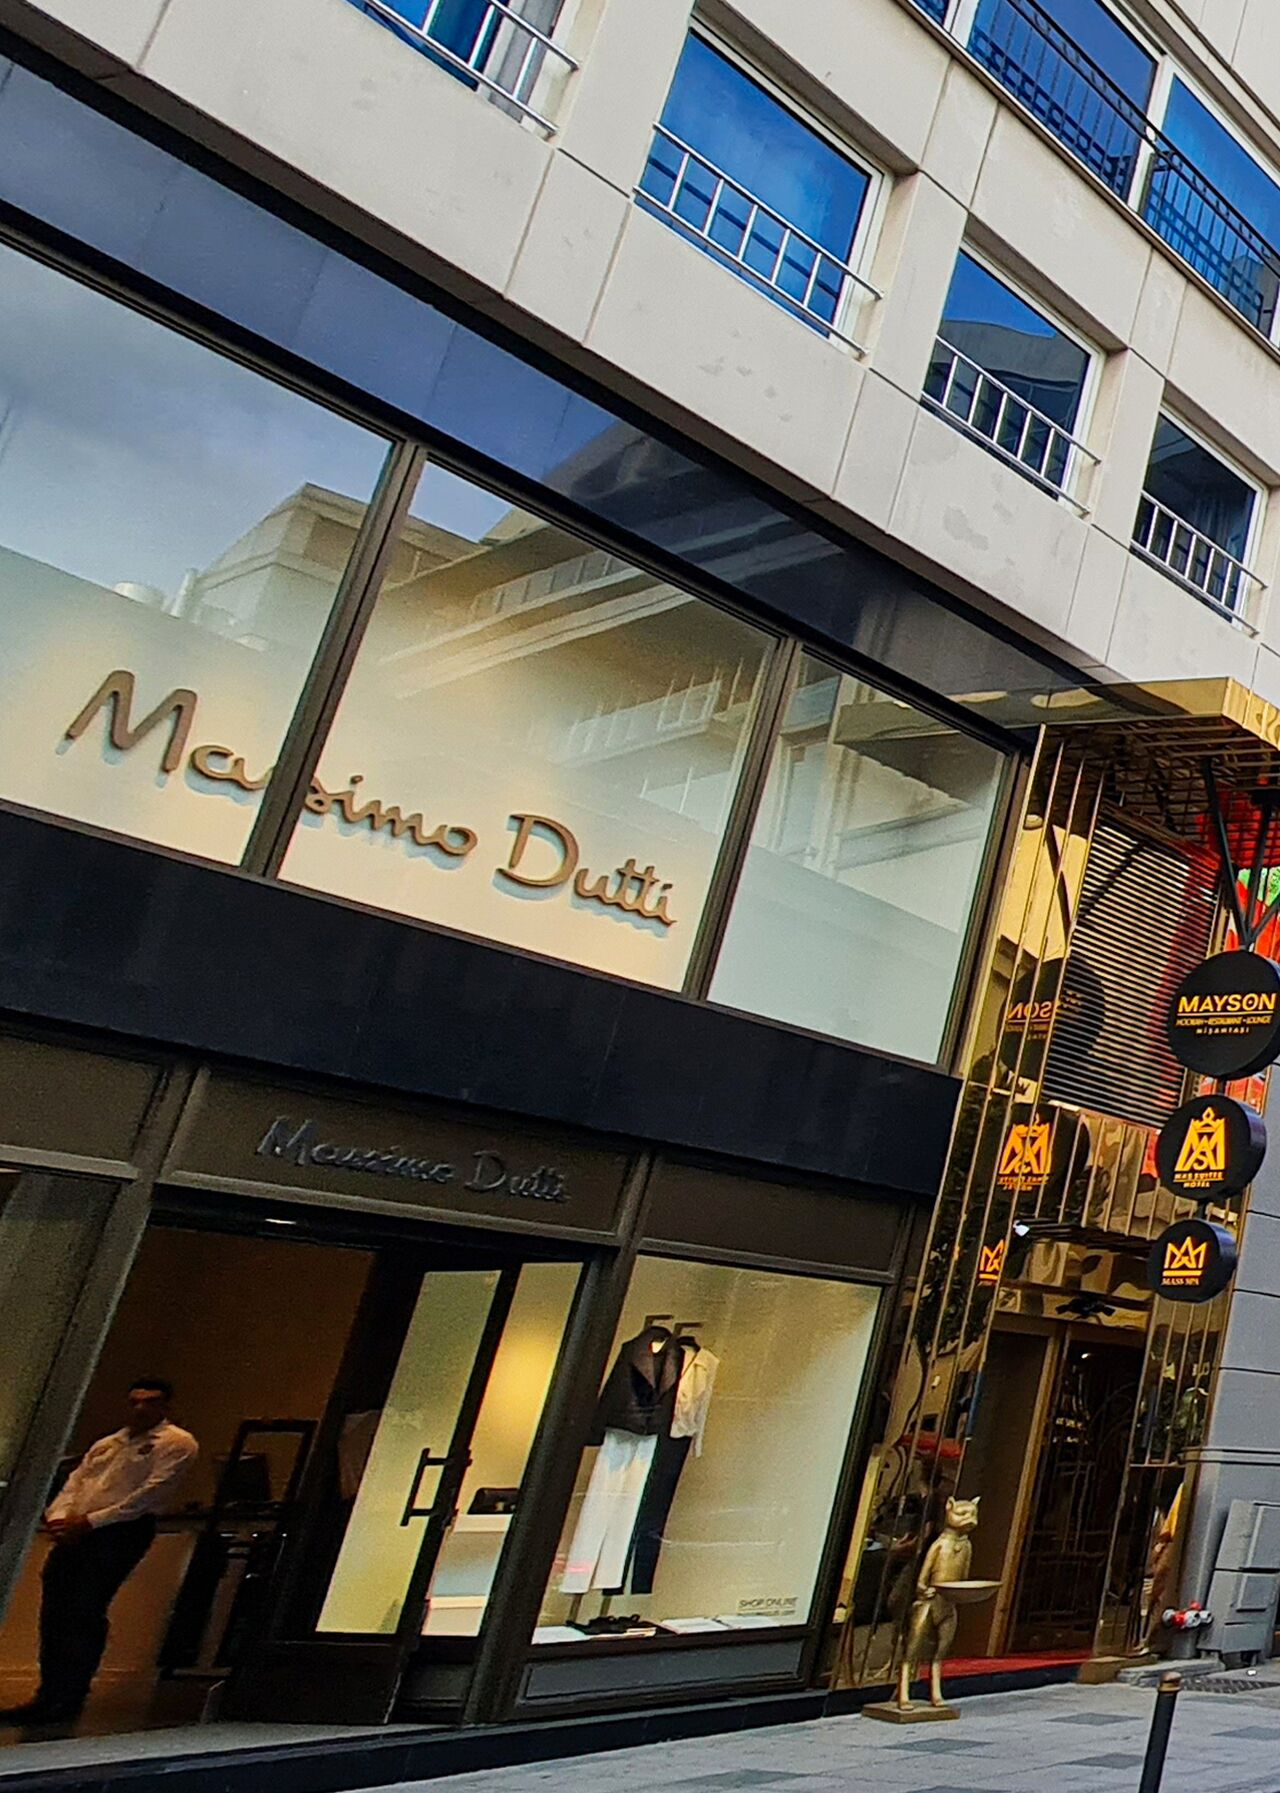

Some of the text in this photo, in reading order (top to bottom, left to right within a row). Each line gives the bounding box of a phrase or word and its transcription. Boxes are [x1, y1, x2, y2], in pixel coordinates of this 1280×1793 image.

[65, 669, 677, 928] Masimo Dutti
[1178, 993, 1277, 1013] MAYSON
[254, 1114, 571, 1203] Massimo Dutti
